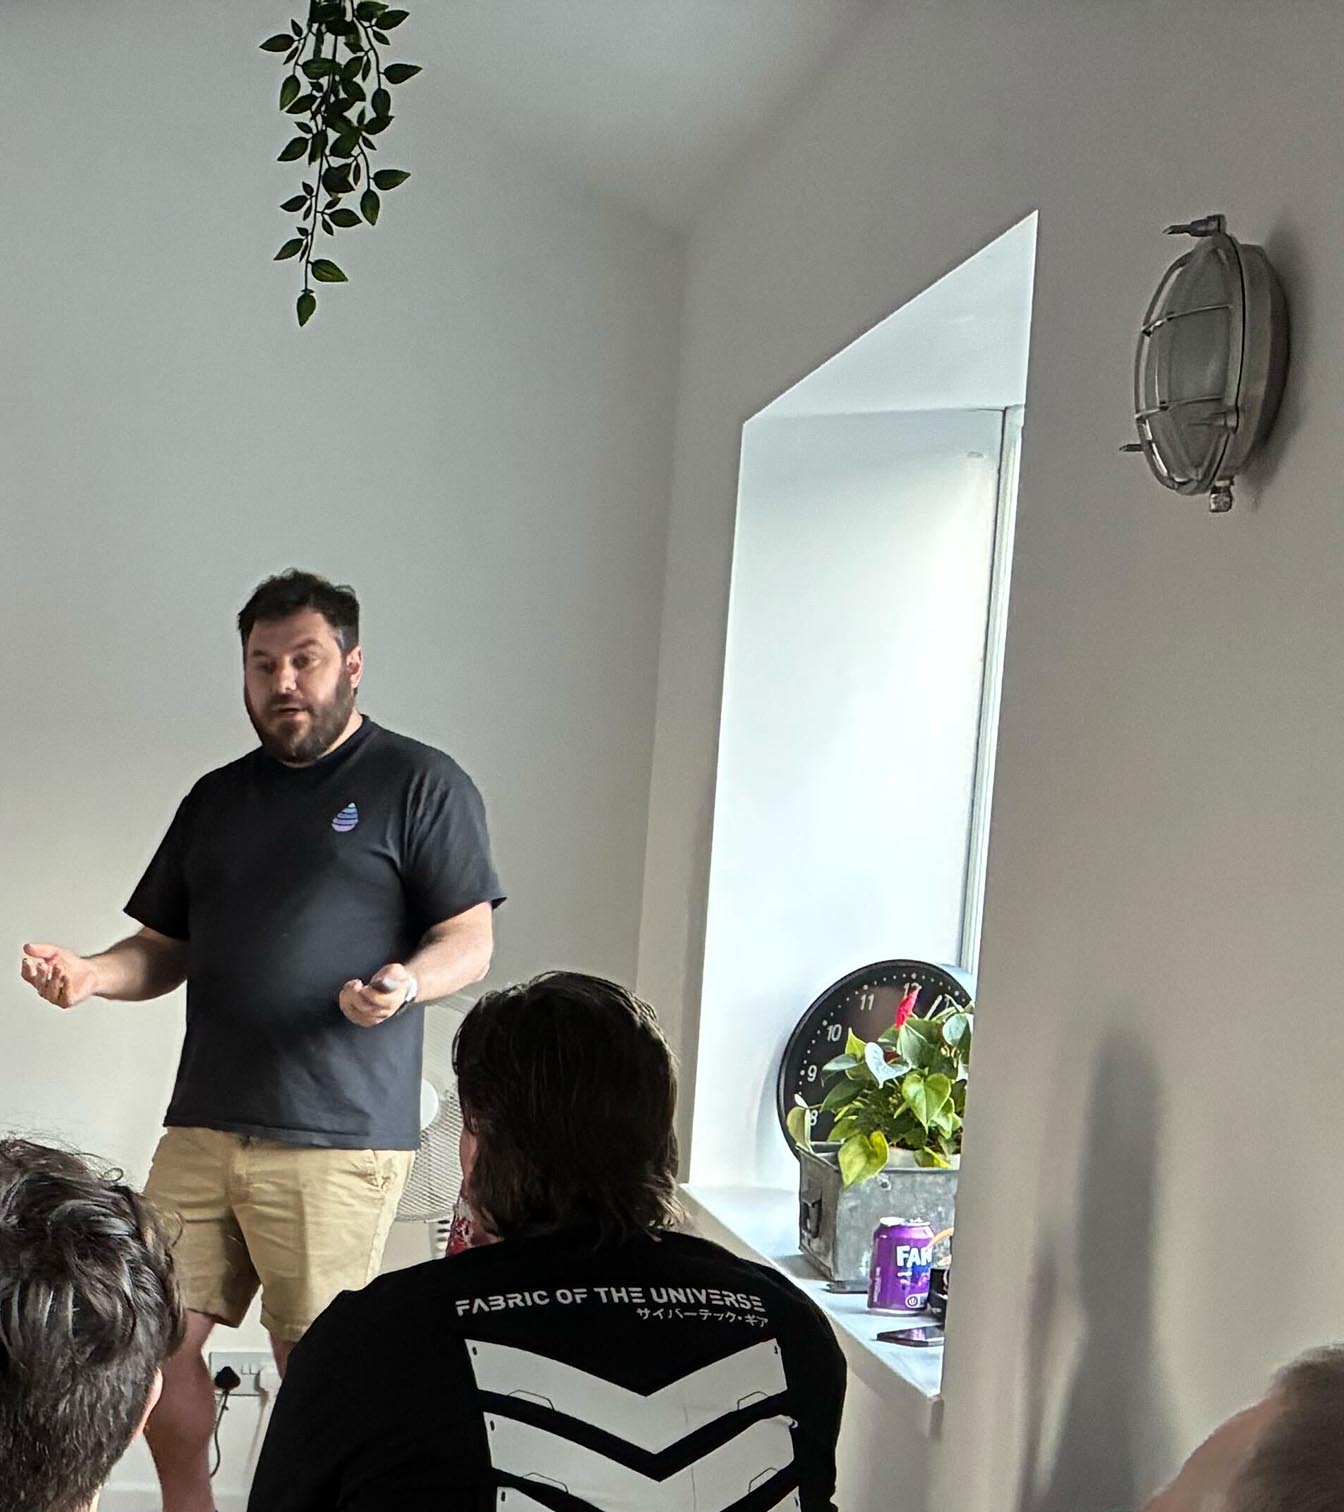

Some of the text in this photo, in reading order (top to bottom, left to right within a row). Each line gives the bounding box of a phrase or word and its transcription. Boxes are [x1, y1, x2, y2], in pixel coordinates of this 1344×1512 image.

[860, 993, 875, 1011] 11
[826, 1023, 843, 1042] 10
[807, 1065, 818, 1082] 9
[808, 1109, 818, 1126] 8
[455, 1286, 766, 1316] FABRIC OF THE UNIVERSE
